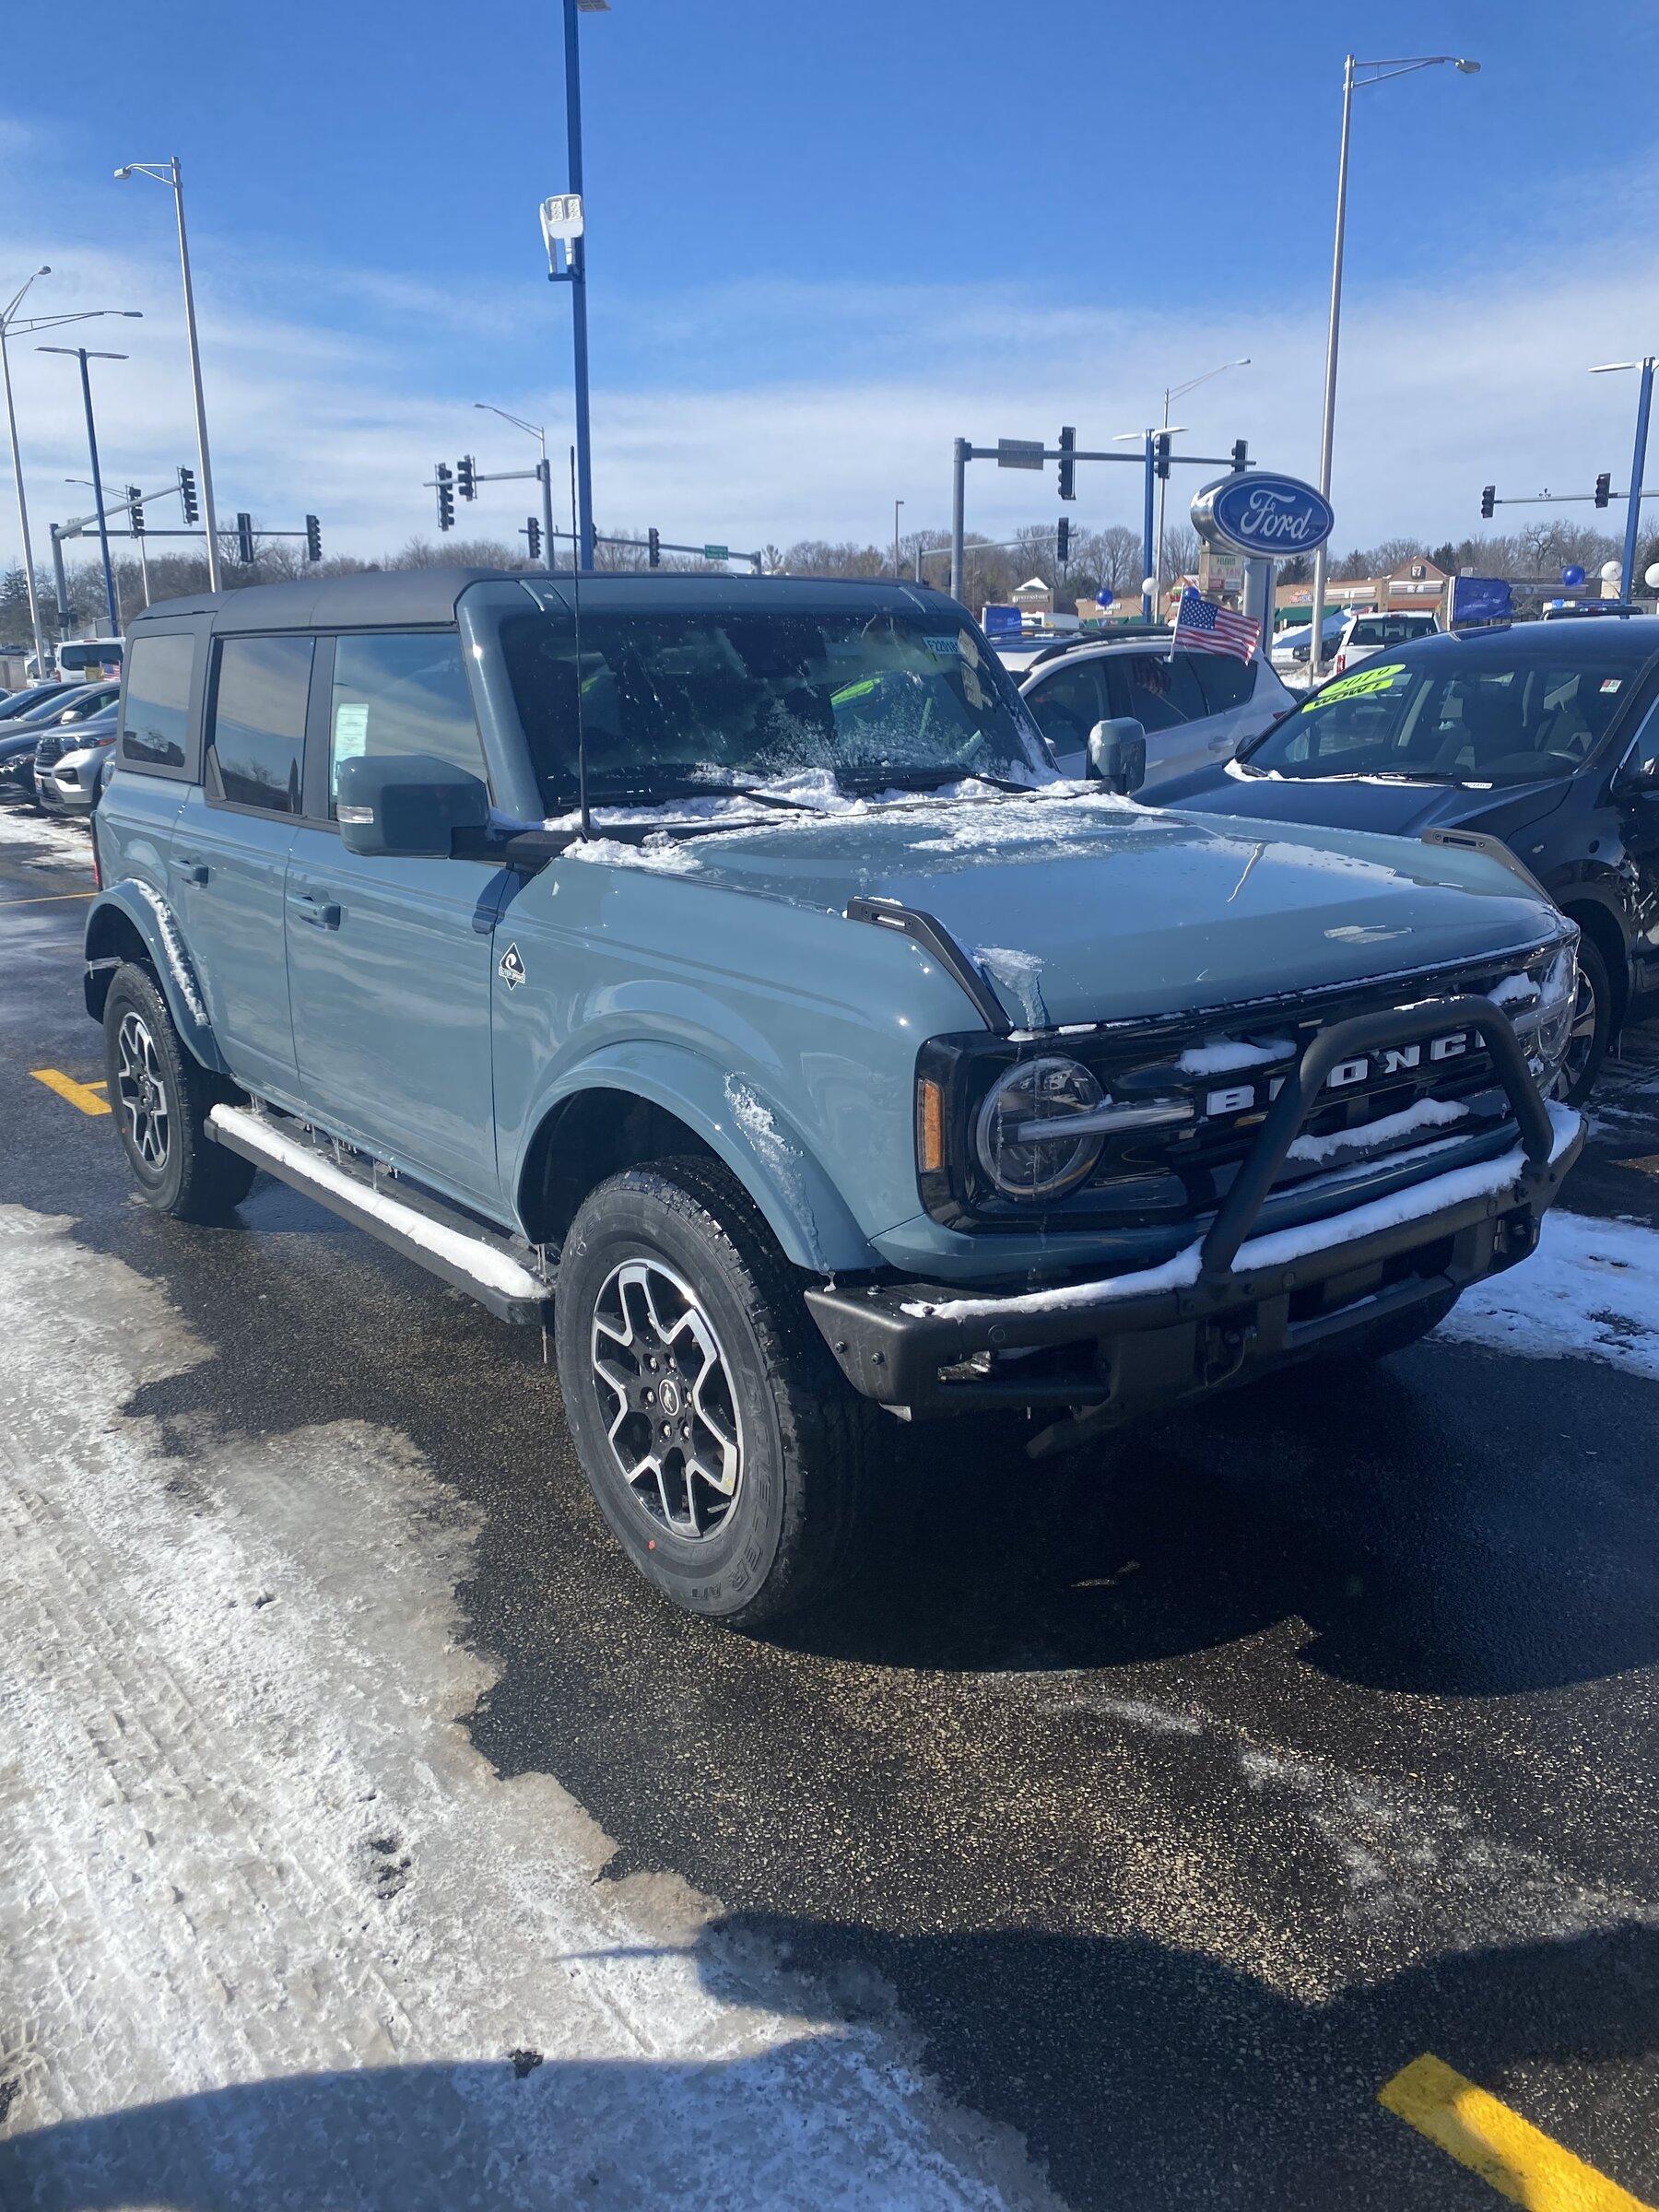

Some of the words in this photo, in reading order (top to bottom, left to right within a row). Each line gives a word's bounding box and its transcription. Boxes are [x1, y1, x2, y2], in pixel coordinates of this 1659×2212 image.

[1240, 489, 1312, 539] Ford
[1206, 1030, 1487, 1116] BONC
[729, 1367, 772, 1592] DUELER
